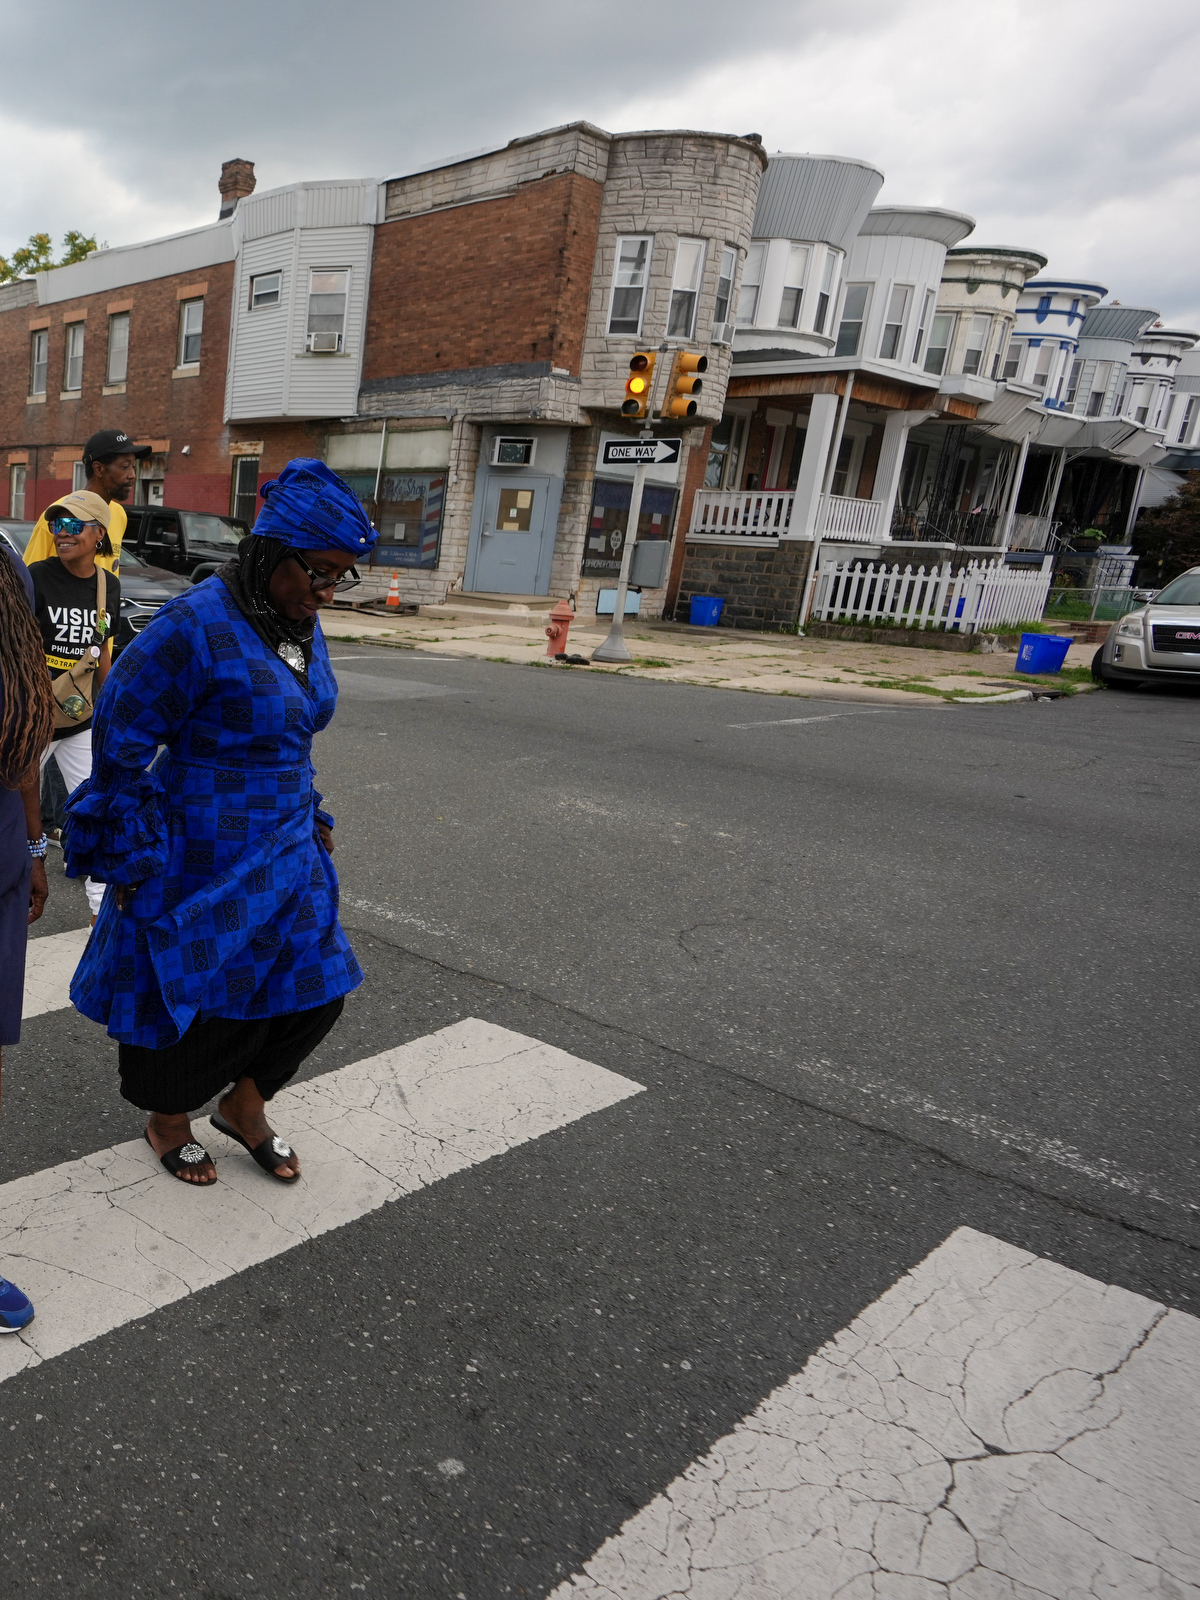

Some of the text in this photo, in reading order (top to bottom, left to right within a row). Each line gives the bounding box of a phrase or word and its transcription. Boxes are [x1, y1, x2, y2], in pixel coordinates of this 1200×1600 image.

[611, 447, 657, 457] ONE WAY
[54, 624, 95, 645] ZER
[1175, 631, 1200, 640] GM
[51, 644, 87, 656] PHILADE
